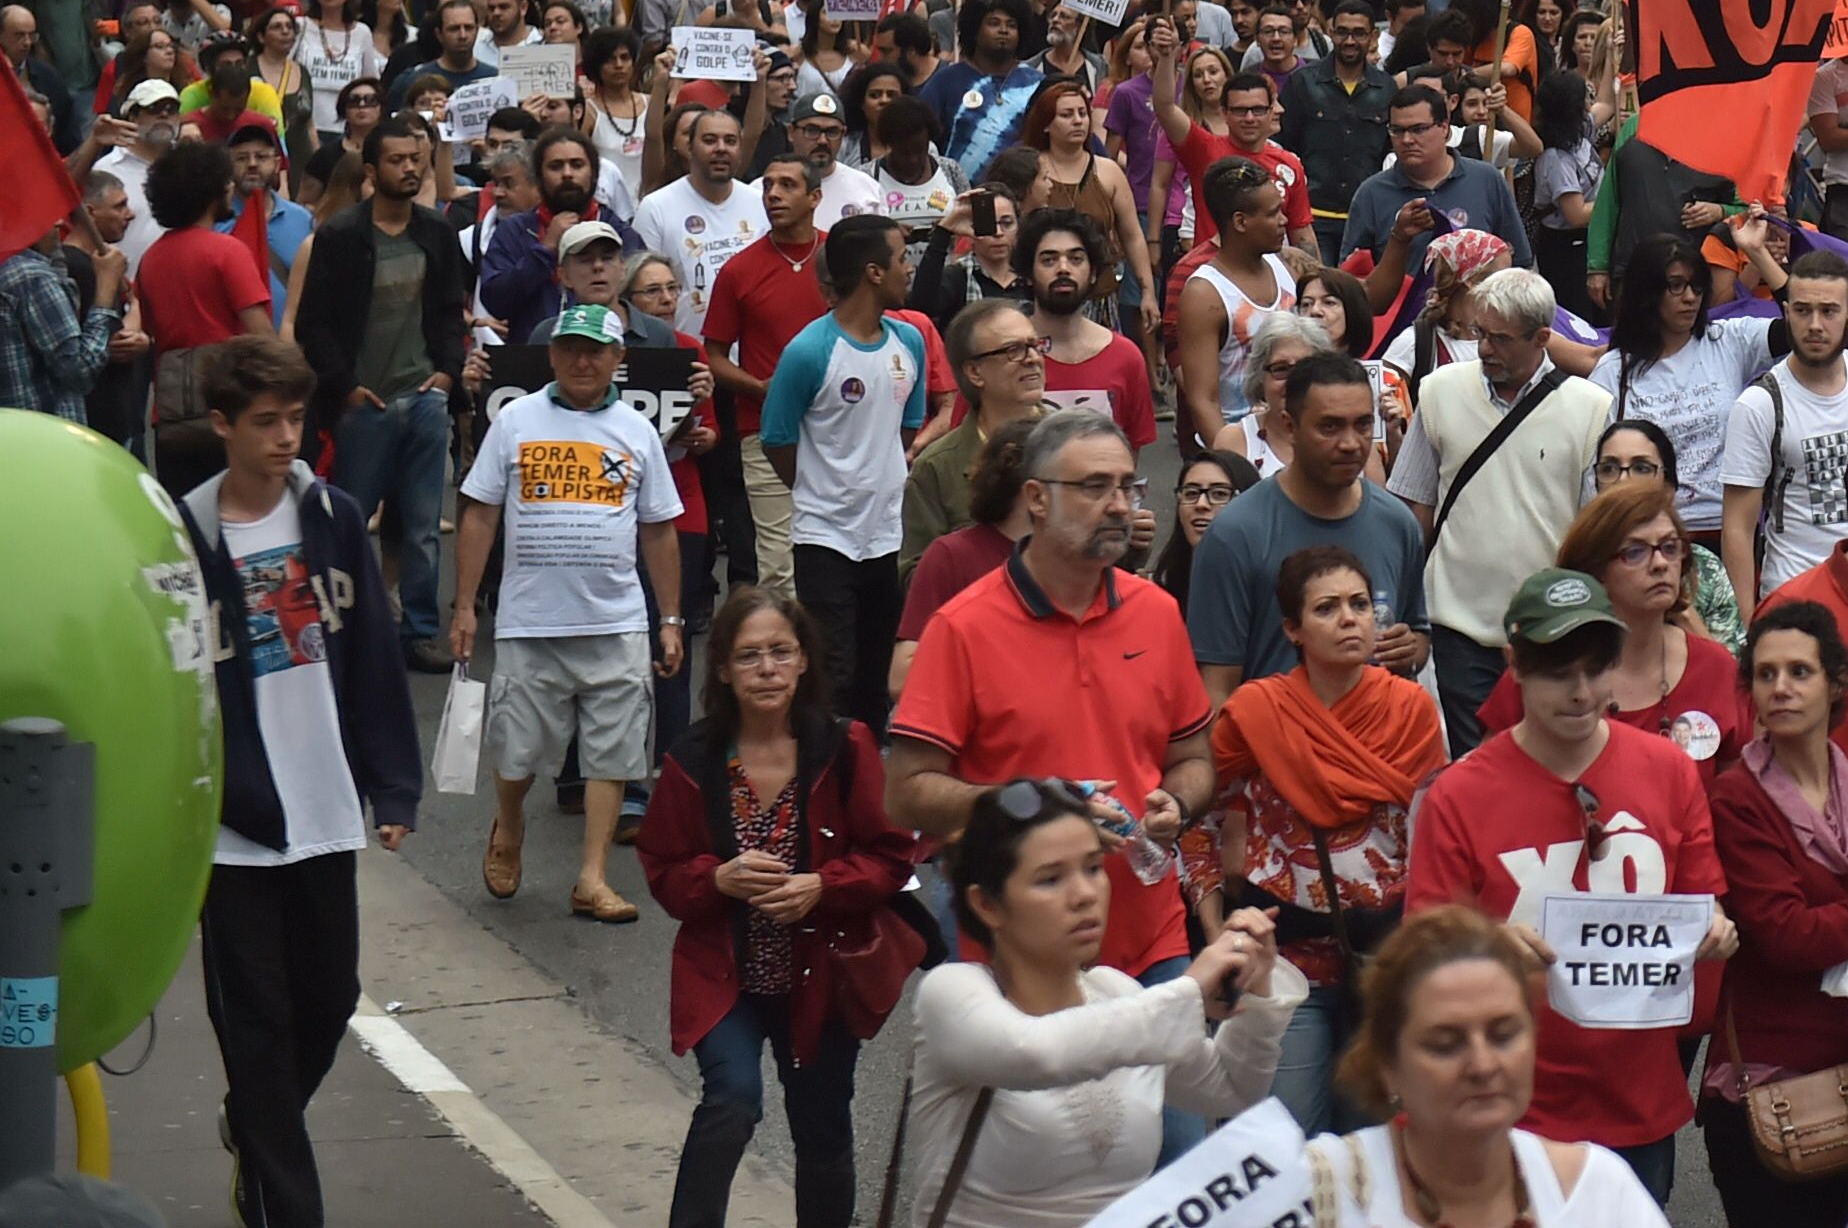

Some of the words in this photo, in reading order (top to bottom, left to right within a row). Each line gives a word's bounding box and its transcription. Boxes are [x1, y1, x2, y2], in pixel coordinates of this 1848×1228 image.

[693, 30, 733, 42] VACINE-SE
[695, 43, 723, 54] CONTRA
[696, 55, 728, 69] GOLPE
[520, 446, 578, 463] FORA
[520, 463, 591, 482] TEMER
[1580, 923, 1673, 948] FORA
[1565, 961, 1682, 987] TEMER
